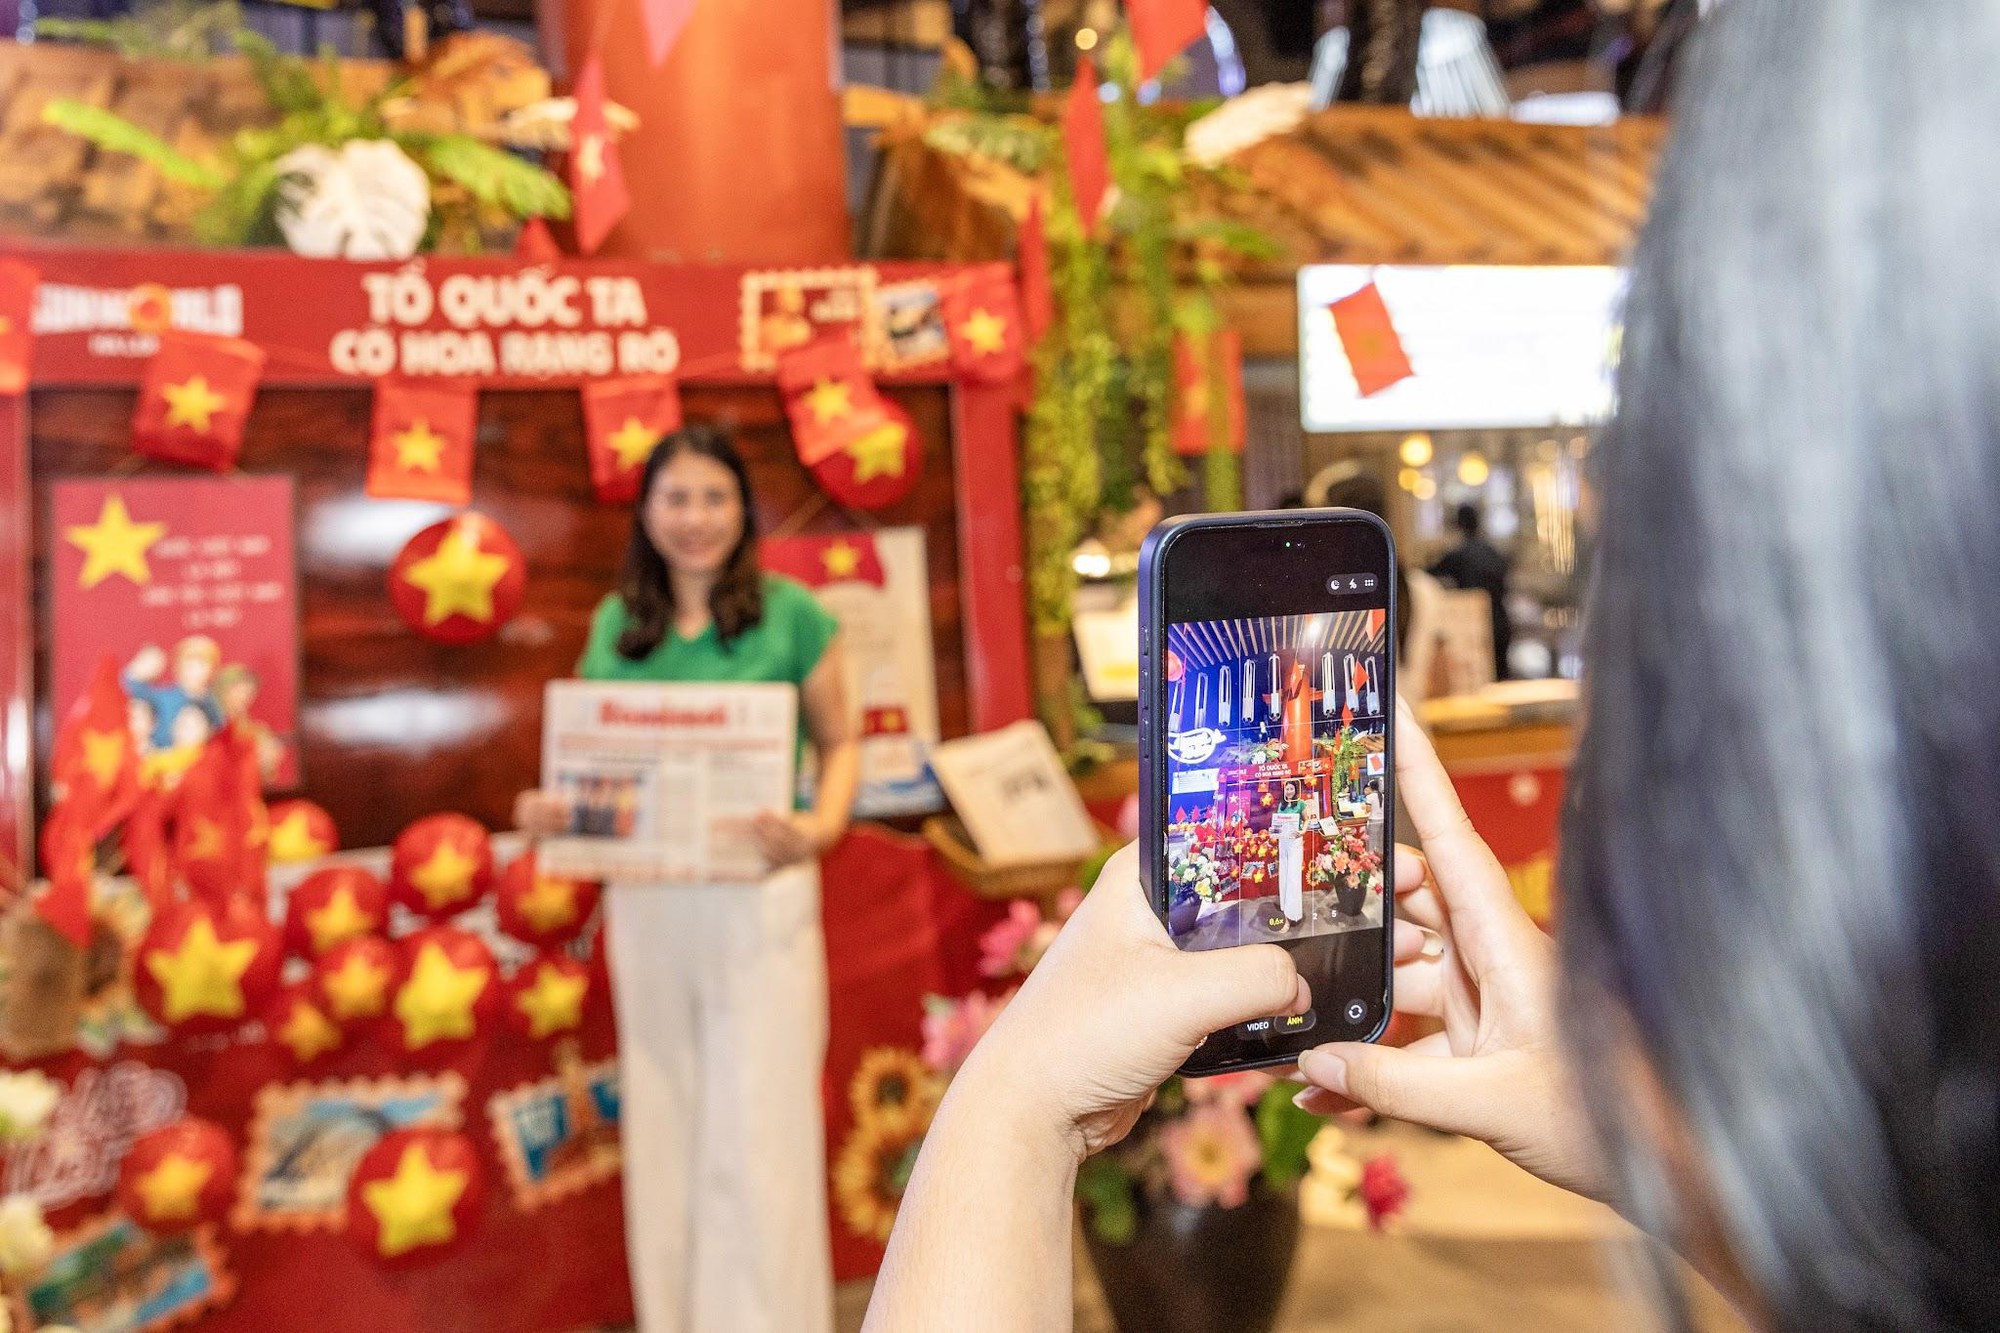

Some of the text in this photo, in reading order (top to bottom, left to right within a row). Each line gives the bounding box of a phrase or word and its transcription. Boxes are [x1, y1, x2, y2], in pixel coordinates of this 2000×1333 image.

[360, 259, 648, 328] TỔ QUỐC TA
[401, 329, 497, 376] HOA
[1331, 910, 1337, 918] 5
[1247, 1021, 1269, 1031] VIDEO
